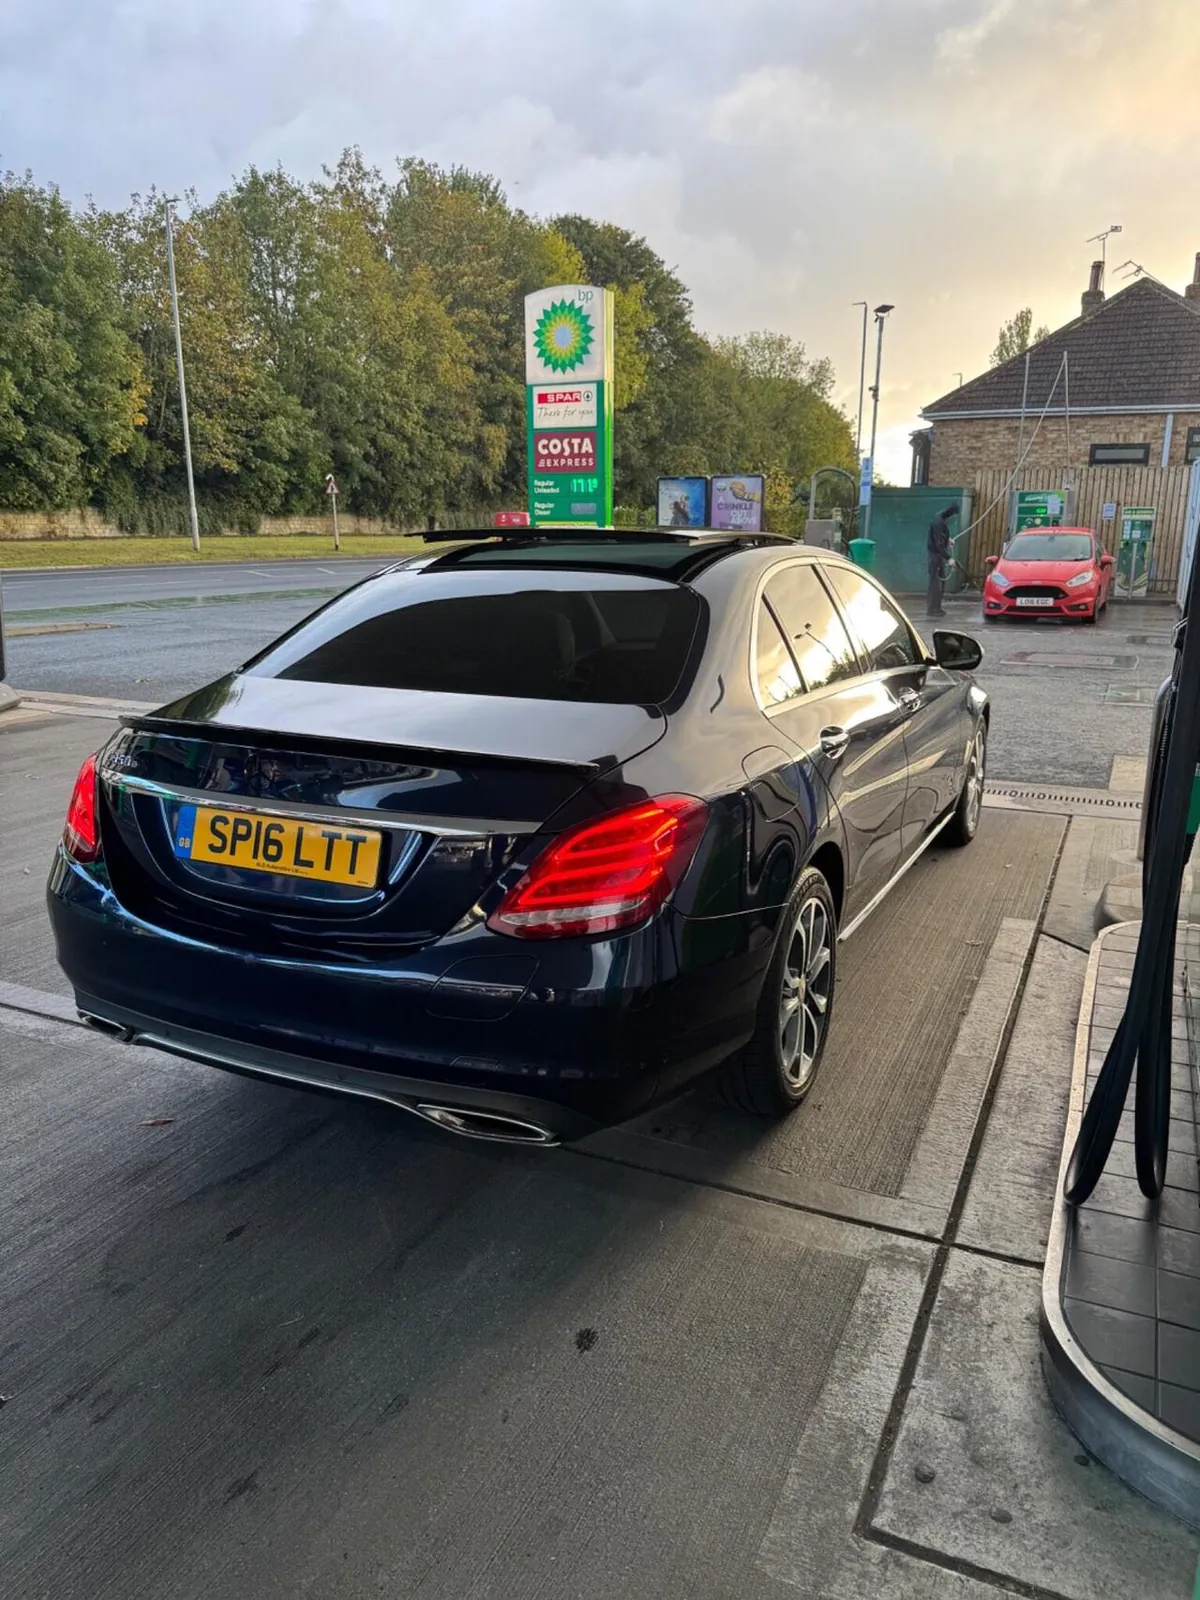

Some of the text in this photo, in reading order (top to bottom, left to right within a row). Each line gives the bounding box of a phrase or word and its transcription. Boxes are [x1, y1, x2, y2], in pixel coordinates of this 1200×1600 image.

[578, 288, 594, 304] bp
[546, 392, 582, 403] SPAR
[537, 405, 594, 420] There for you
[538, 437, 593, 456] COSTA
[546, 457, 594, 467] EXPRESS
[208, 814, 367, 875] SP16 LTT
